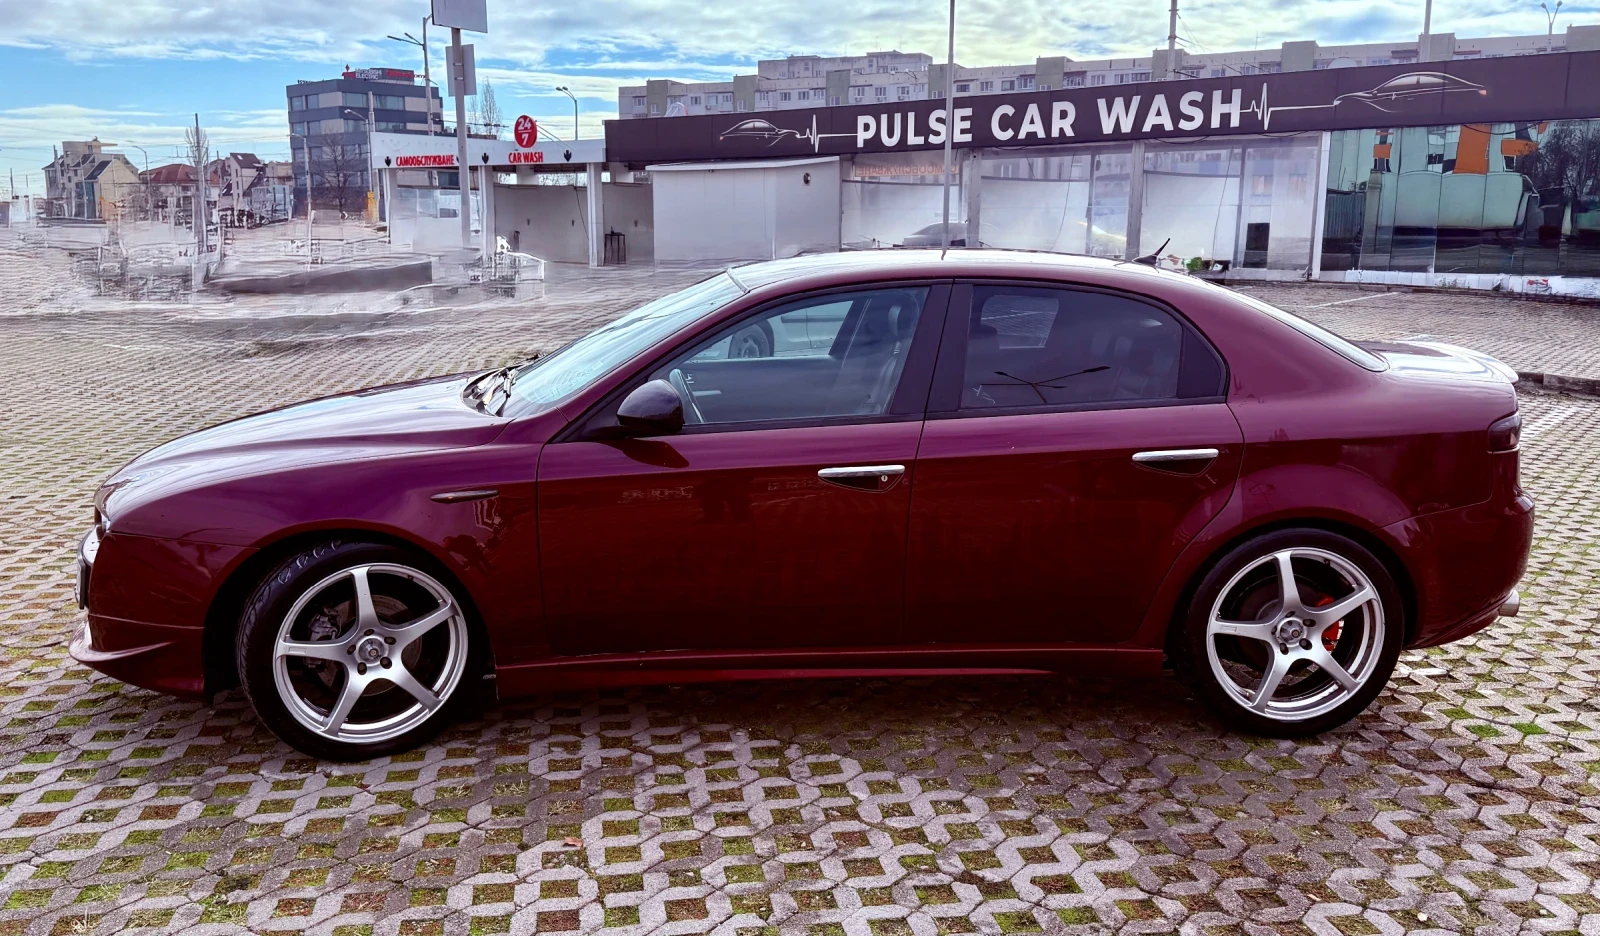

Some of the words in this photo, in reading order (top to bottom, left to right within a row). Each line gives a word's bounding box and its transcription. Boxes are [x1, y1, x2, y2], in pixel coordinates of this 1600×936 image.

[518, 117, 532, 130] 24
[857, 108, 973, 148] PULSE
[990, 101, 1076, 141] CAR
[1097, 88, 1242, 135] WASH
[521, 133, 529, 146] 7
[395, 154, 455, 167] САМООБСЛУЖВАНЕ
[508, 152, 522, 164] CAR
[522, 151, 544, 163] WASH
